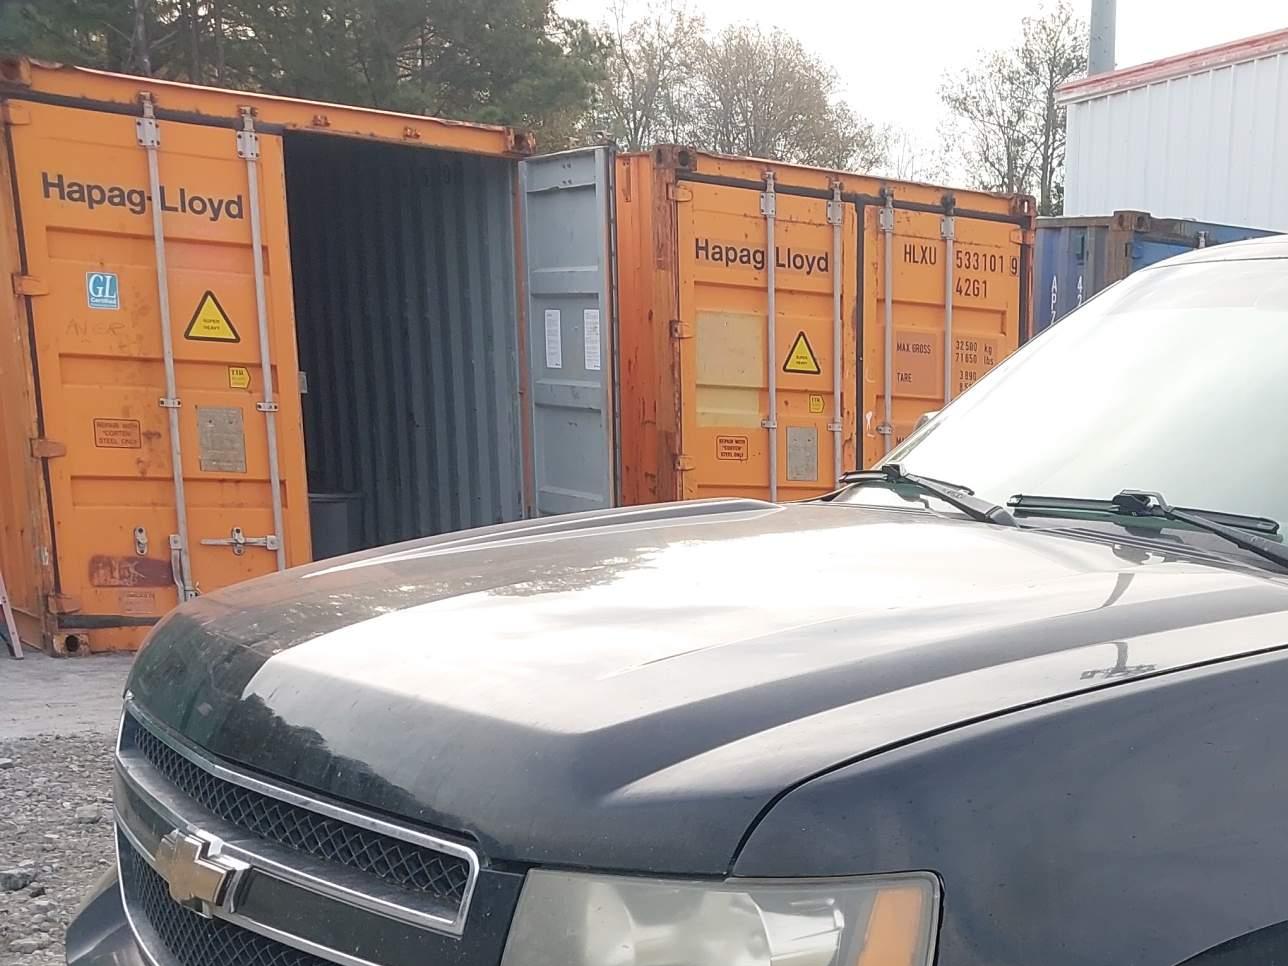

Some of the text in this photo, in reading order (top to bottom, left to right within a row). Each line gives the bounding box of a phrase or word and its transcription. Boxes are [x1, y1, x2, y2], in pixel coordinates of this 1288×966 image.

[904, 244, 938, 265] HLXU
[956, 250, 1004, 273] 533101
[89, 274, 117, 298] GL
[956, 277, 987, 298] 42G1
[896, 342, 910, 352] MAX
[912, 343, 932, 354] GROSS
[896, 372, 913, 383] TARE
